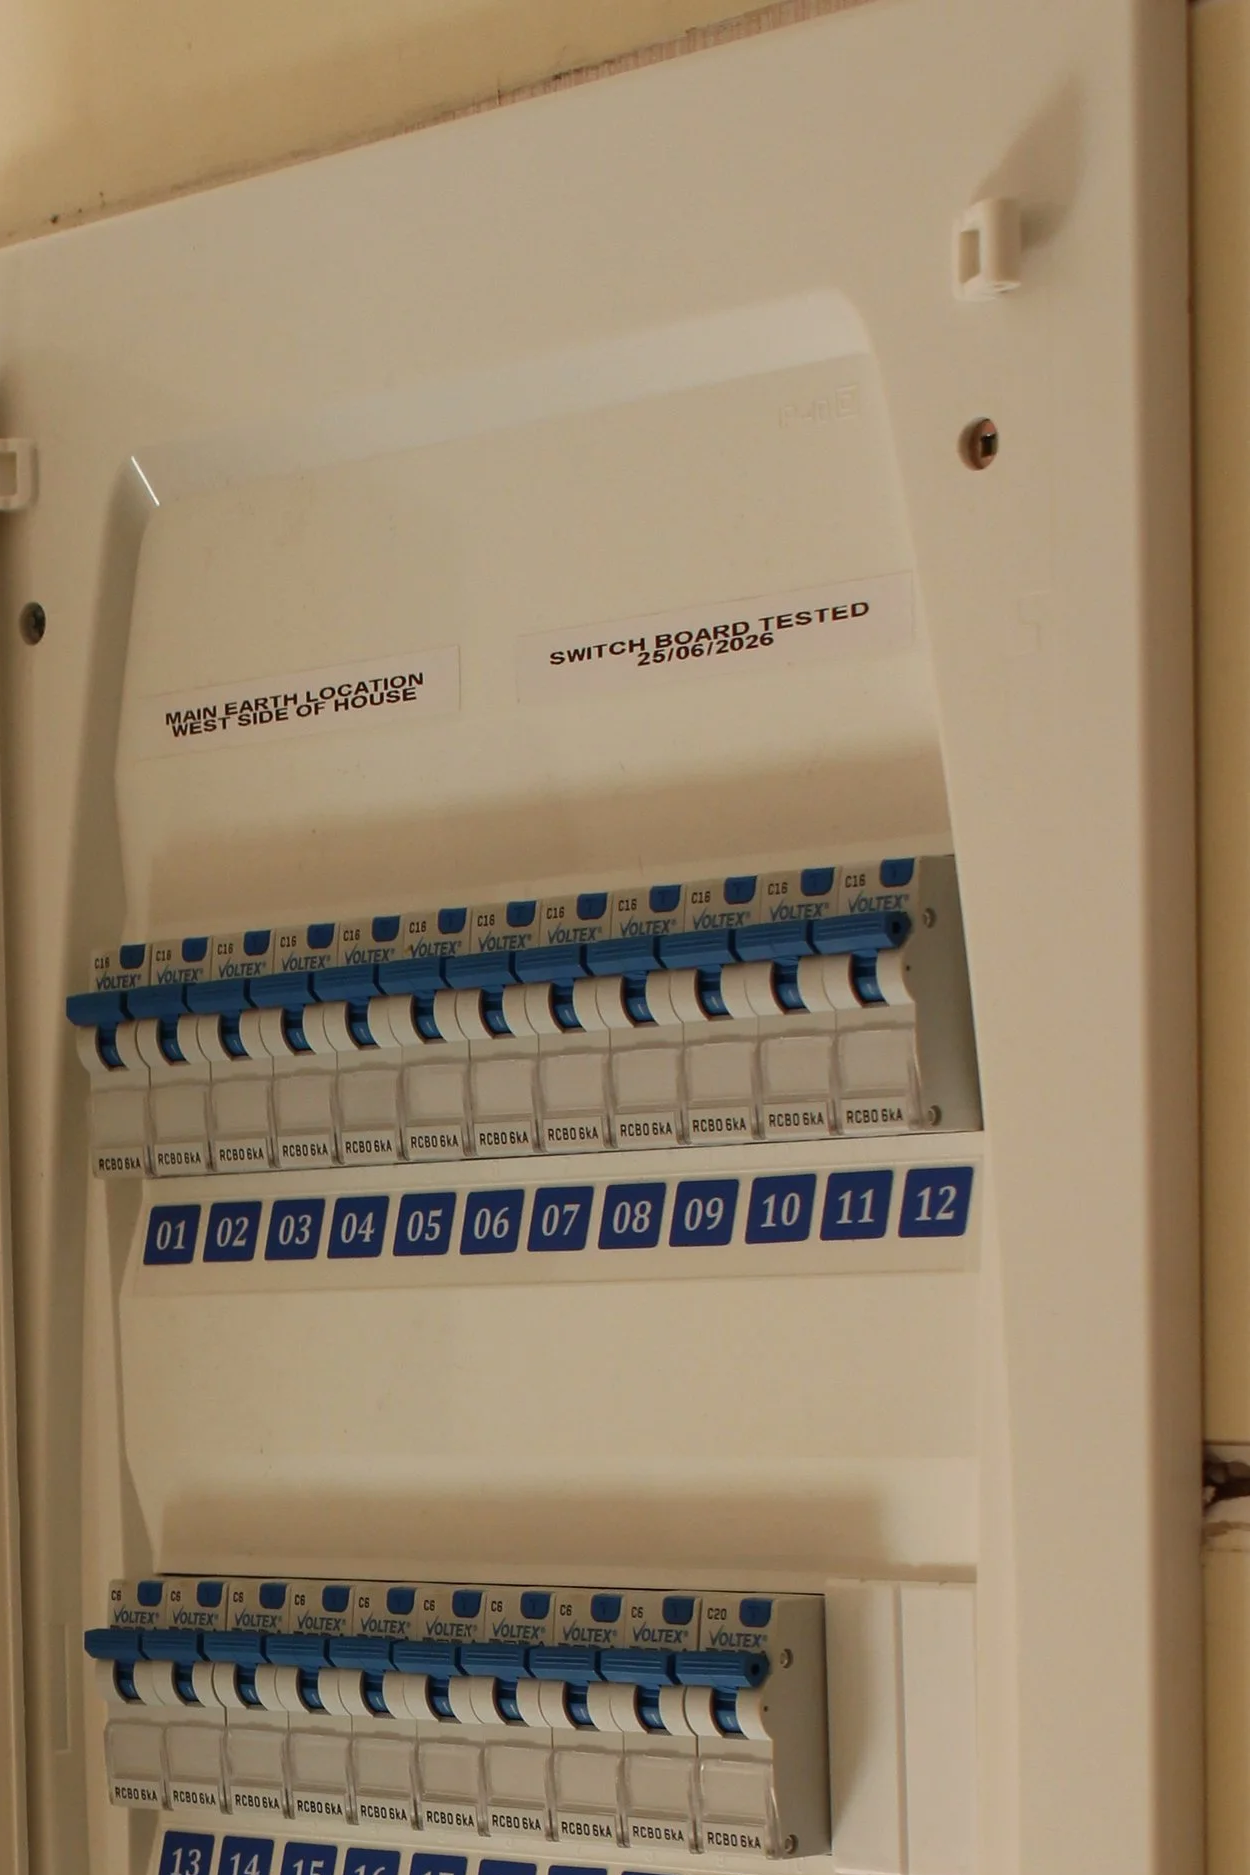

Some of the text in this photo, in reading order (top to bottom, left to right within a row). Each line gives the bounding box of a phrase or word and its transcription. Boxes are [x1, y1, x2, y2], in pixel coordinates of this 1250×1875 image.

[550, 602, 870, 666] SWITCH BOARD TESTED
[637, 632, 775, 667] 25/06/2026
[165, 672, 424, 725] MAIN EARTH LOCATION
[171, 687, 418, 738] WEST SIDE OF HOUSE
[613, 1201, 651, 1233] 08
[916, 1185, 956, 1221] 12
[157, 1220, 185, 1250] 01
[217, 1218, 249, 1248] 02
[407, 1209, 442, 1240] 05
